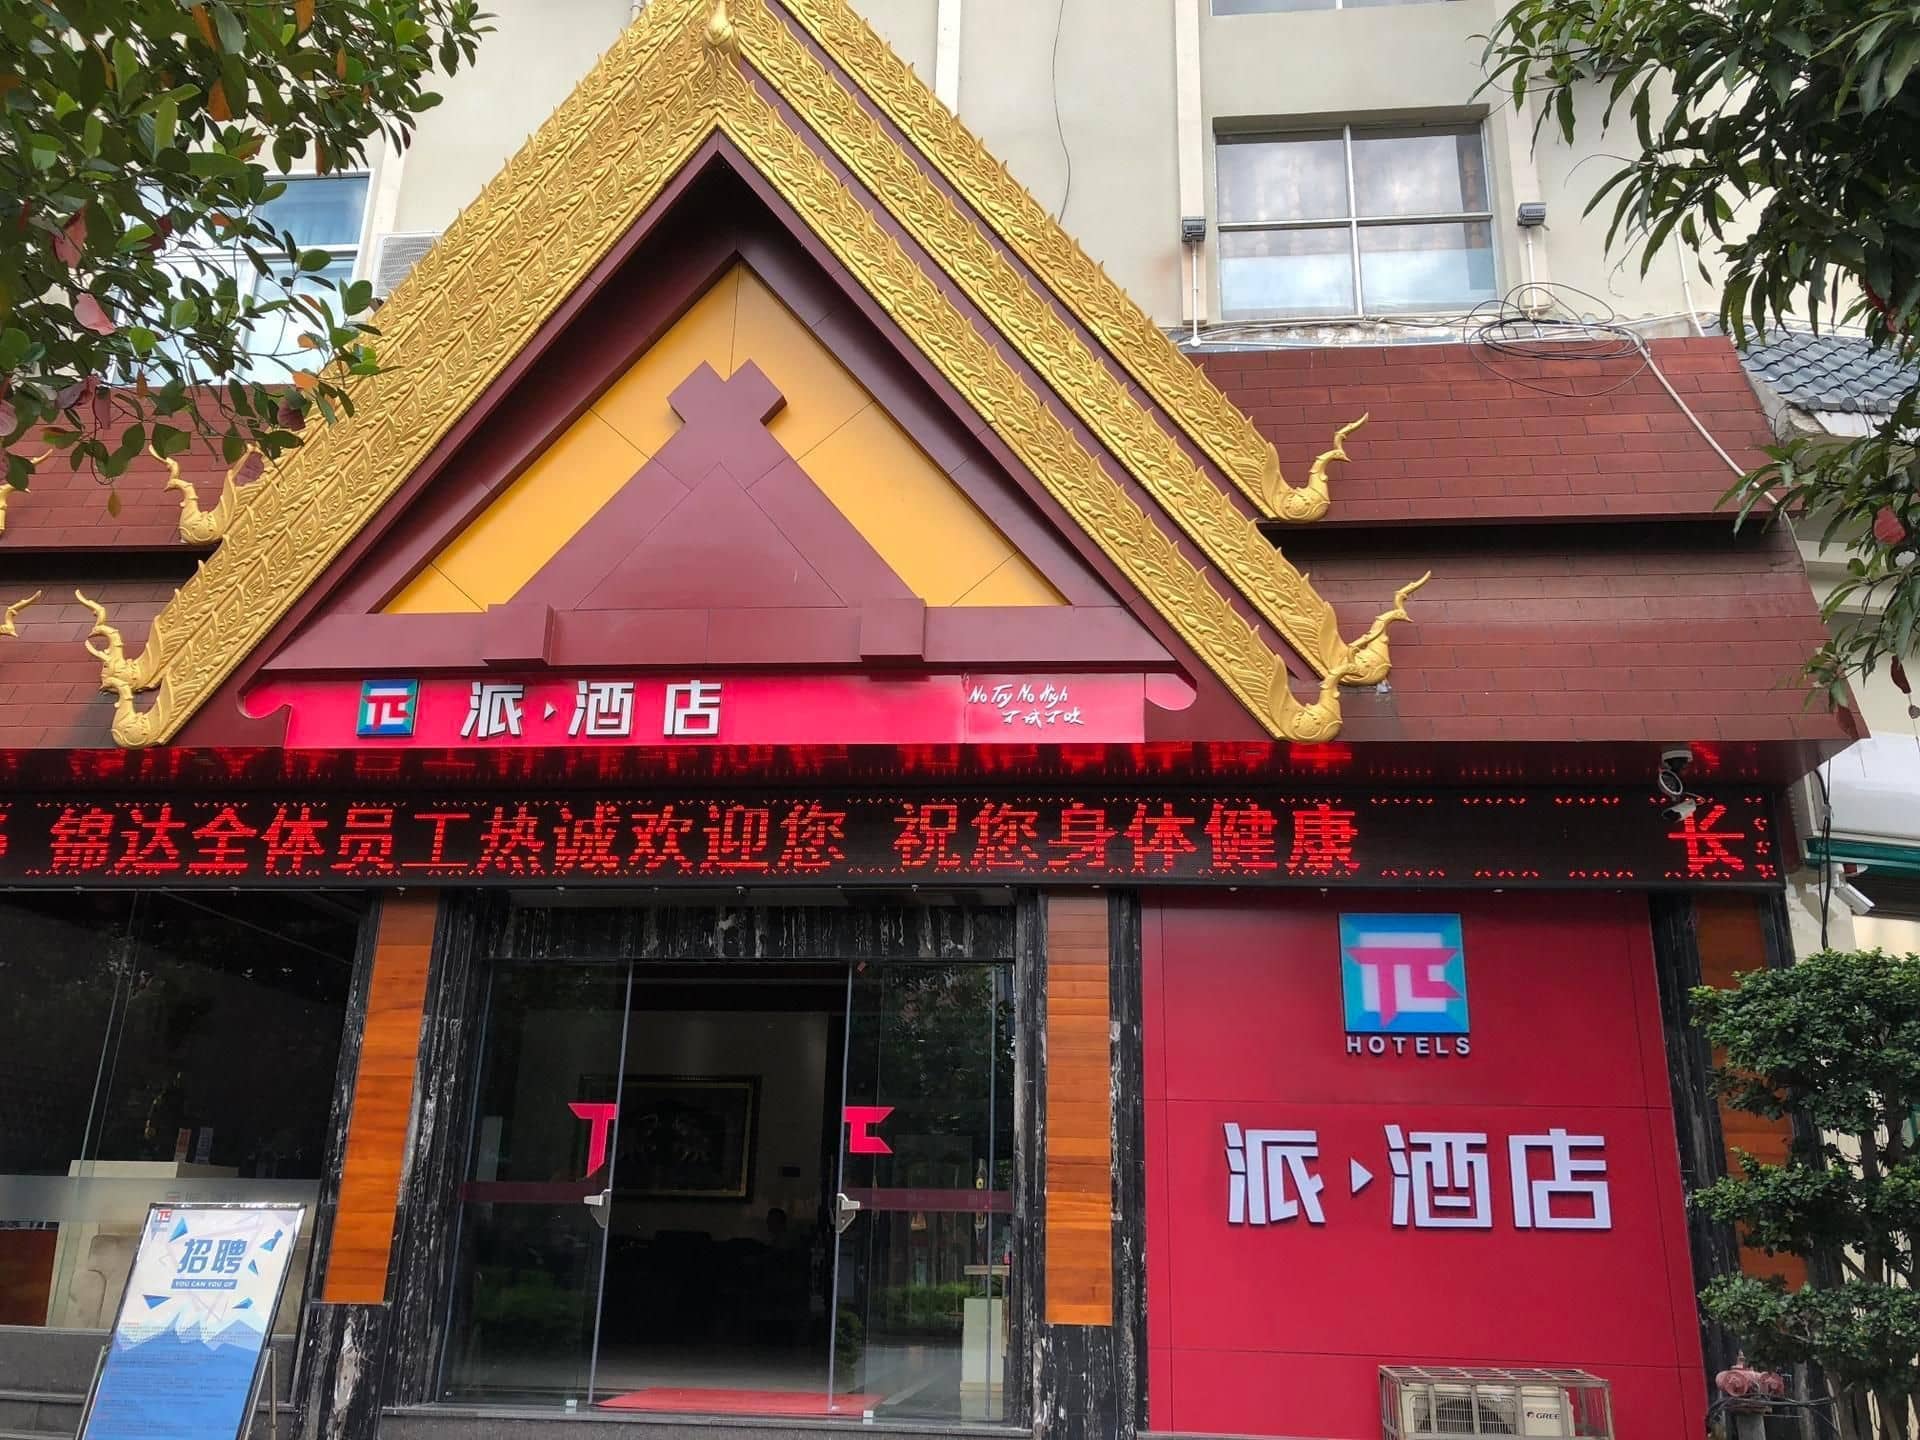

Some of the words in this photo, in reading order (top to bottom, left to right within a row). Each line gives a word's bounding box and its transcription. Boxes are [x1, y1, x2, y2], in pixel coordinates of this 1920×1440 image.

[968, 685, 988, 704] No
[990, 684, 1014, 709] Try
[1016, 683, 1036, 703] No
[1345, 1036, 1471, 1055] HOTELS
[176, 1238, 248, 1274] 招聘
[1536, 1412, 1560, 1420] GREE
